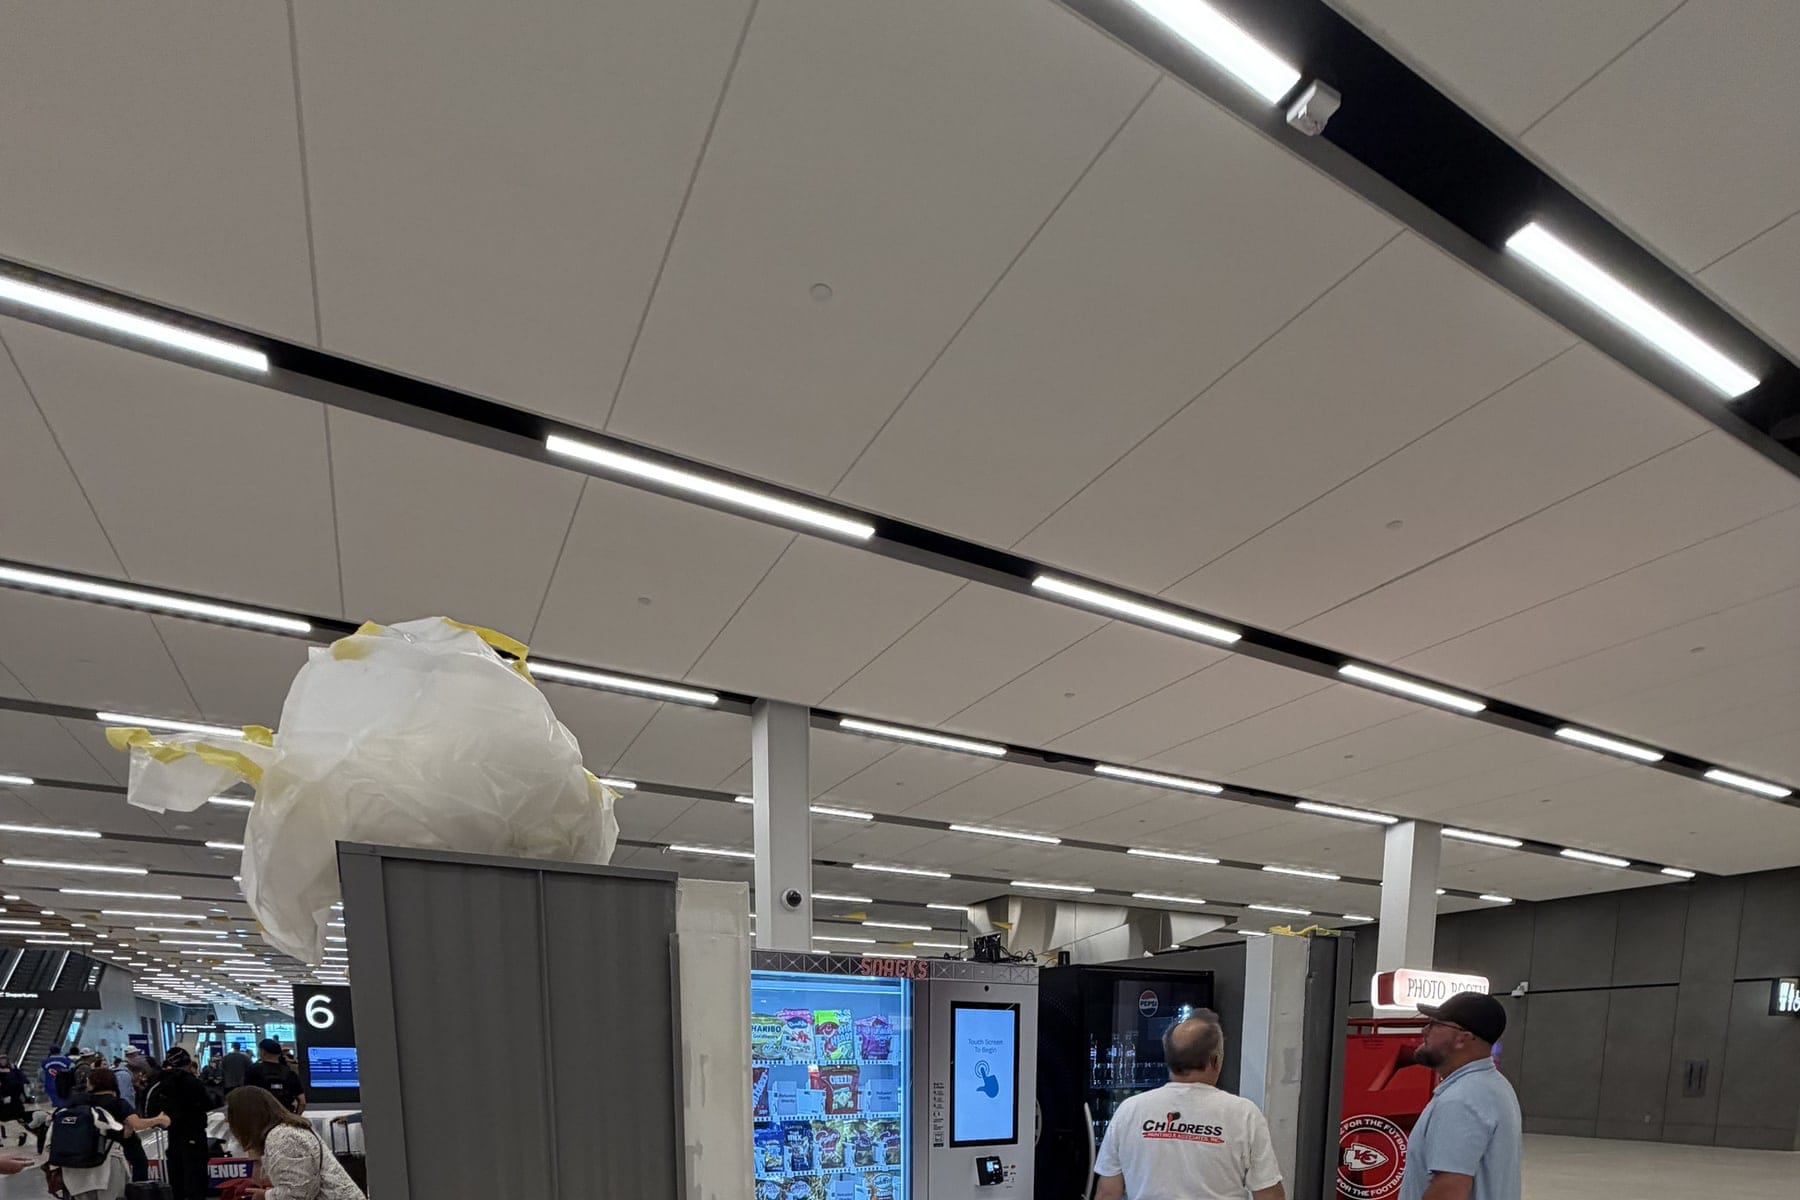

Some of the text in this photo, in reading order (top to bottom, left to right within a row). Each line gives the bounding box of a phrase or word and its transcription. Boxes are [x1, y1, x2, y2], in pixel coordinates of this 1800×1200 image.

[861, 958, 929, 979] SNACKS
[1407, 978, 1446, 999] PHOTO
[305, 994, 335, 1029] 6
[982, 1047, 997, 1055] Begin
[1142, 1113, 1223, 1136] CHILDRESS
[1344, 1120, 1362, 1130] FOR
[1365, 1119, 1383, 1127] THE
[208, 1164, 247, 1178] ENUE
[1353, 1188, 1370, 1197] THE
